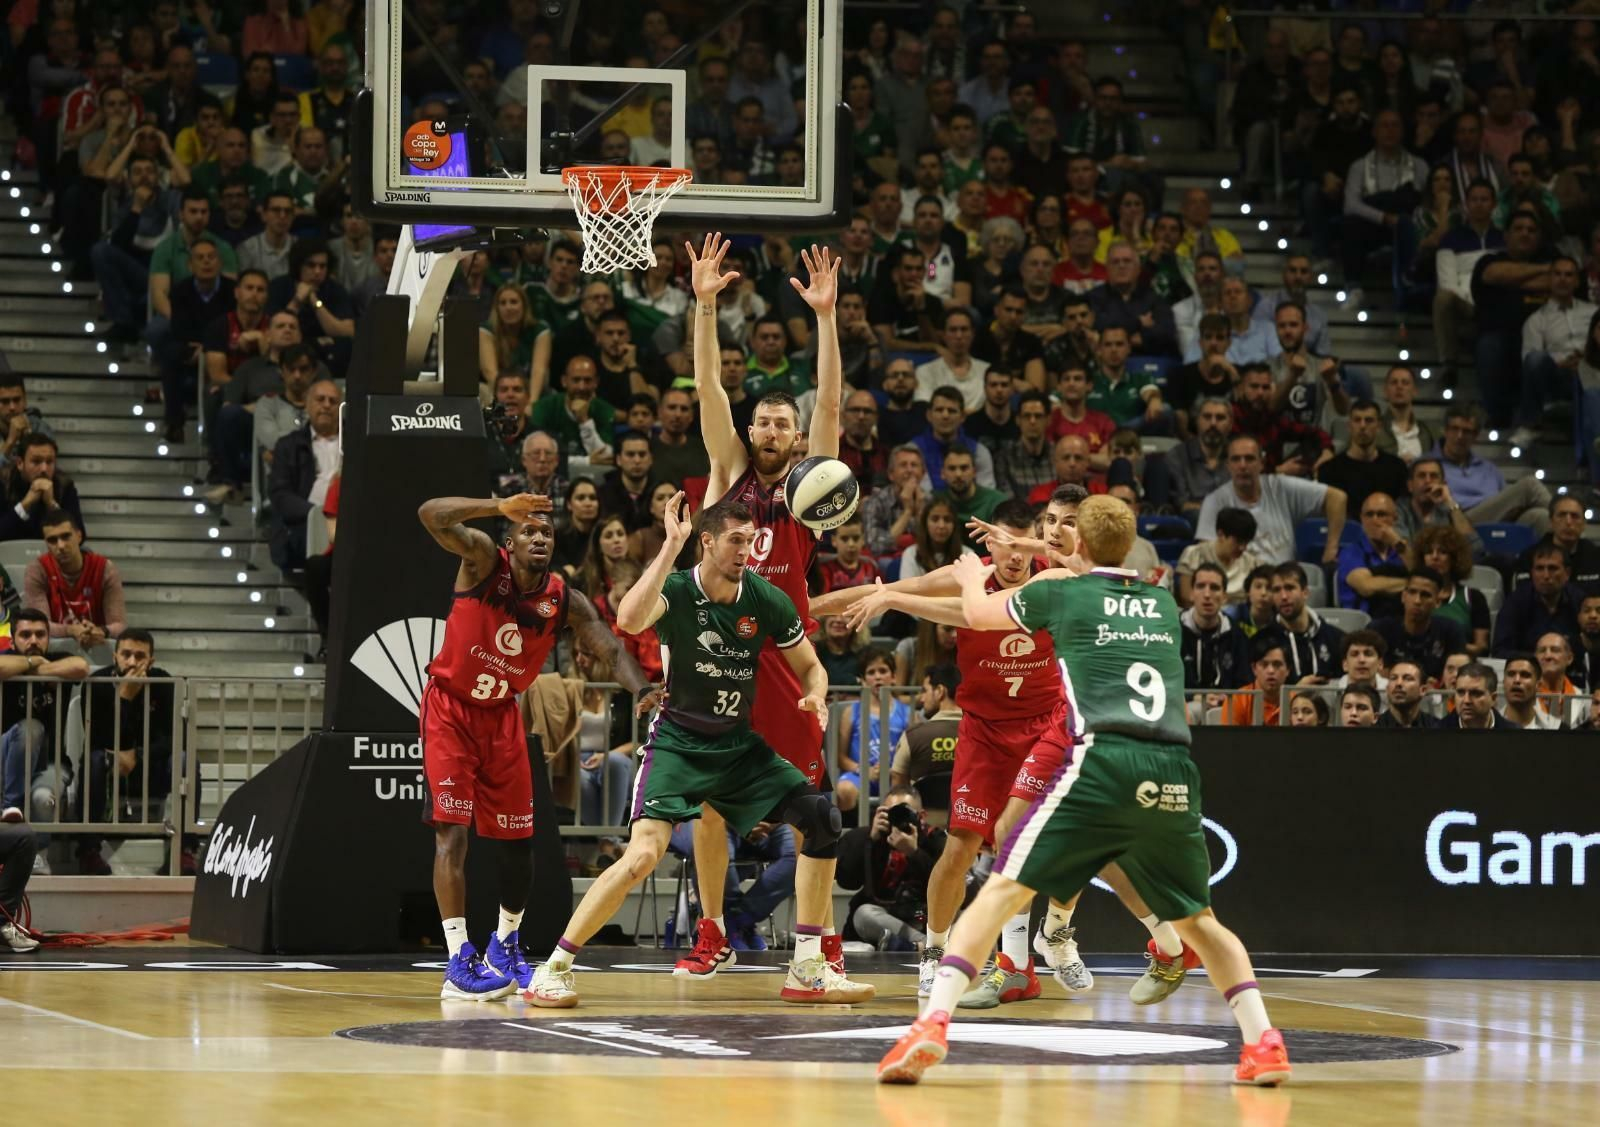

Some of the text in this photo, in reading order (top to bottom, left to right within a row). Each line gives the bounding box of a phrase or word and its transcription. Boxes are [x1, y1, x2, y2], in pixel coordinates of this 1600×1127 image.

[411, 139, 436, 148] Copa
[423, 148, 440, 158] Rey
[384, 192, 430, 202] SPALDING
[391, 414, 463, 431] SPALDING
[1103, 594, 1162, 618] DÍAZ
[470, 673, 509, 700] 31
[1004, 676, 1024, 697] 7
[1126, 662, 1166, 722] 9
[713, 690, 741, 717] 32
[354, 736, 423, 759] Fund
[932, 737, 958, 752] CO
[375, 774, 424, 800] Uni
[1162, 784, 1189, 794] COSTA
[1425, 810, 1600, 885] Gam
